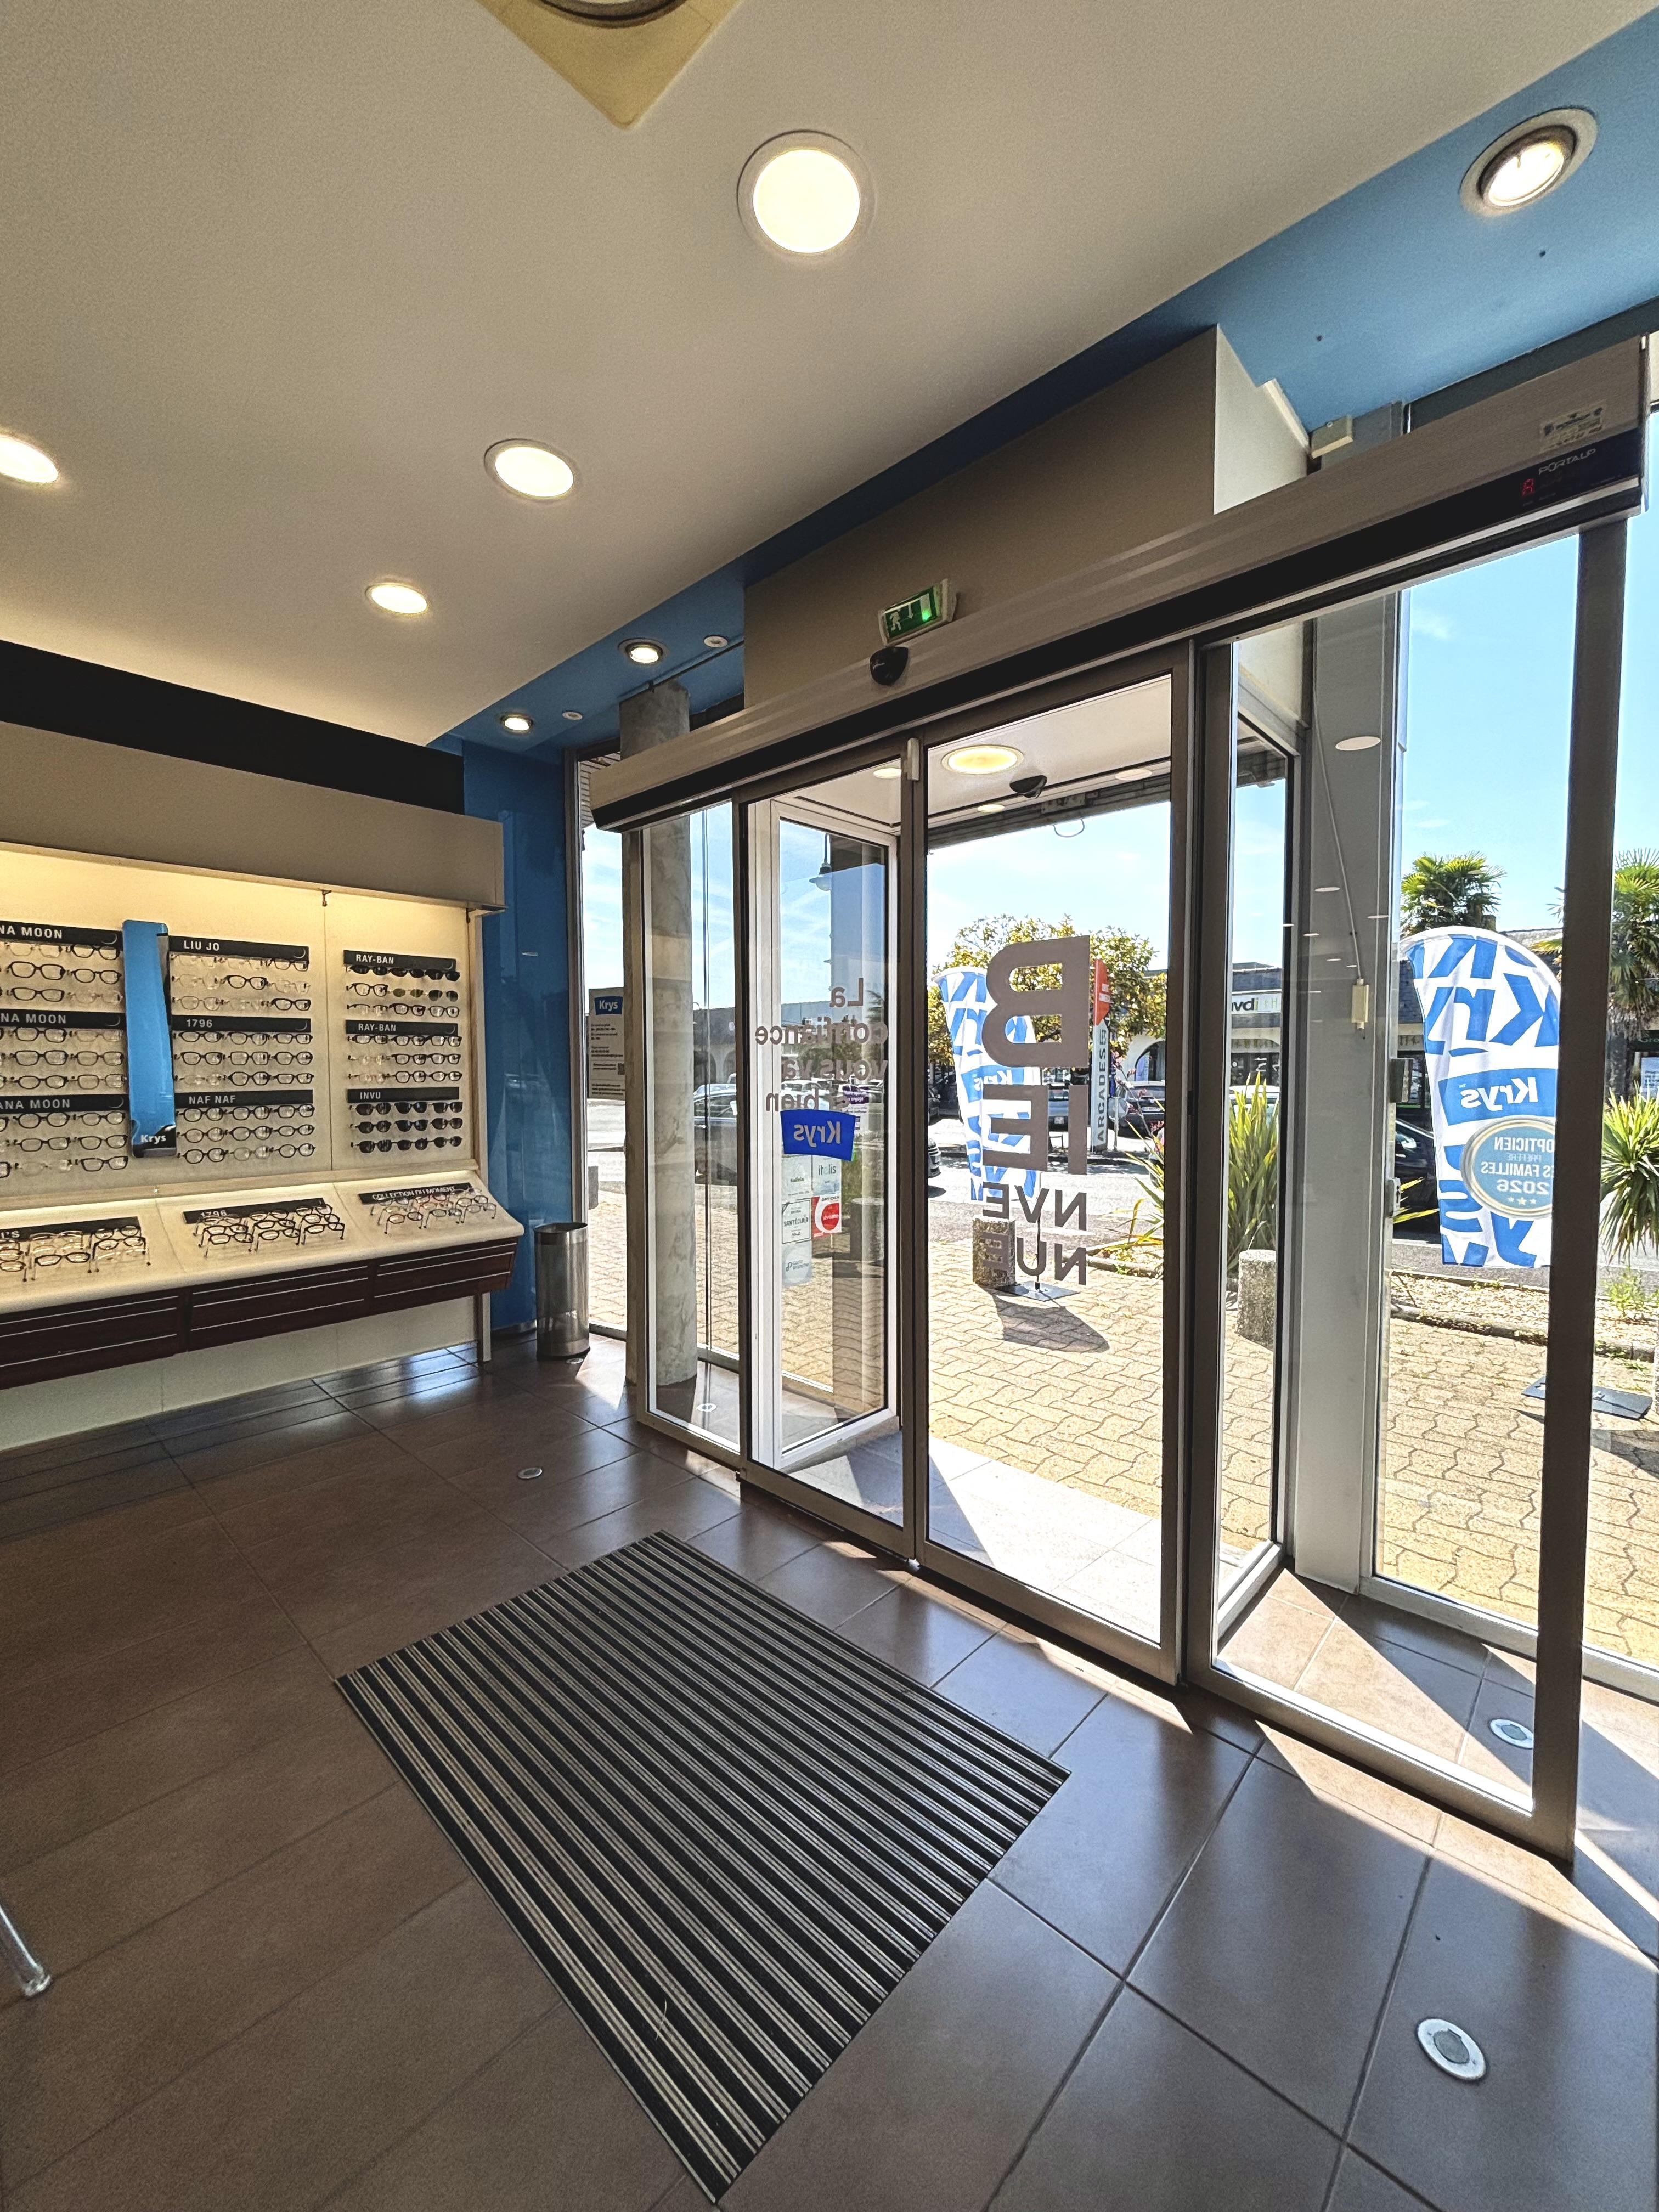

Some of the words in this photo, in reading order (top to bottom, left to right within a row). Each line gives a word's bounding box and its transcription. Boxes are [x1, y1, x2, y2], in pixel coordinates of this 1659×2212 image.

[1538, 448, 1596, 475] PORTALP
[21, 927, 63, 939] MOON
[184, 940, 202, 950] LIU
[206, 941, 220, 951] JO
[356, 954, 394, 964] RAY-BAN
[599, 1000, 618, 1011] Krys
[26, 1013, 66, 1024] MOON
[187, 1019, 213, 1028] 1796
[358, 1023, 396, 1032] RAY-BAN
[189, 1096, 211, 1104] NAF
[215, 1095, 236, 1104] NAF
[360, 1092, 381, 1100] INVU
[1097, 1048, 1106, 1142] ARCADES
[30, 1099, 70, 1109] MOON
[140, 1133, 167, 1144] Krys
[372, 1192, 415, 1200] COLLECTION
